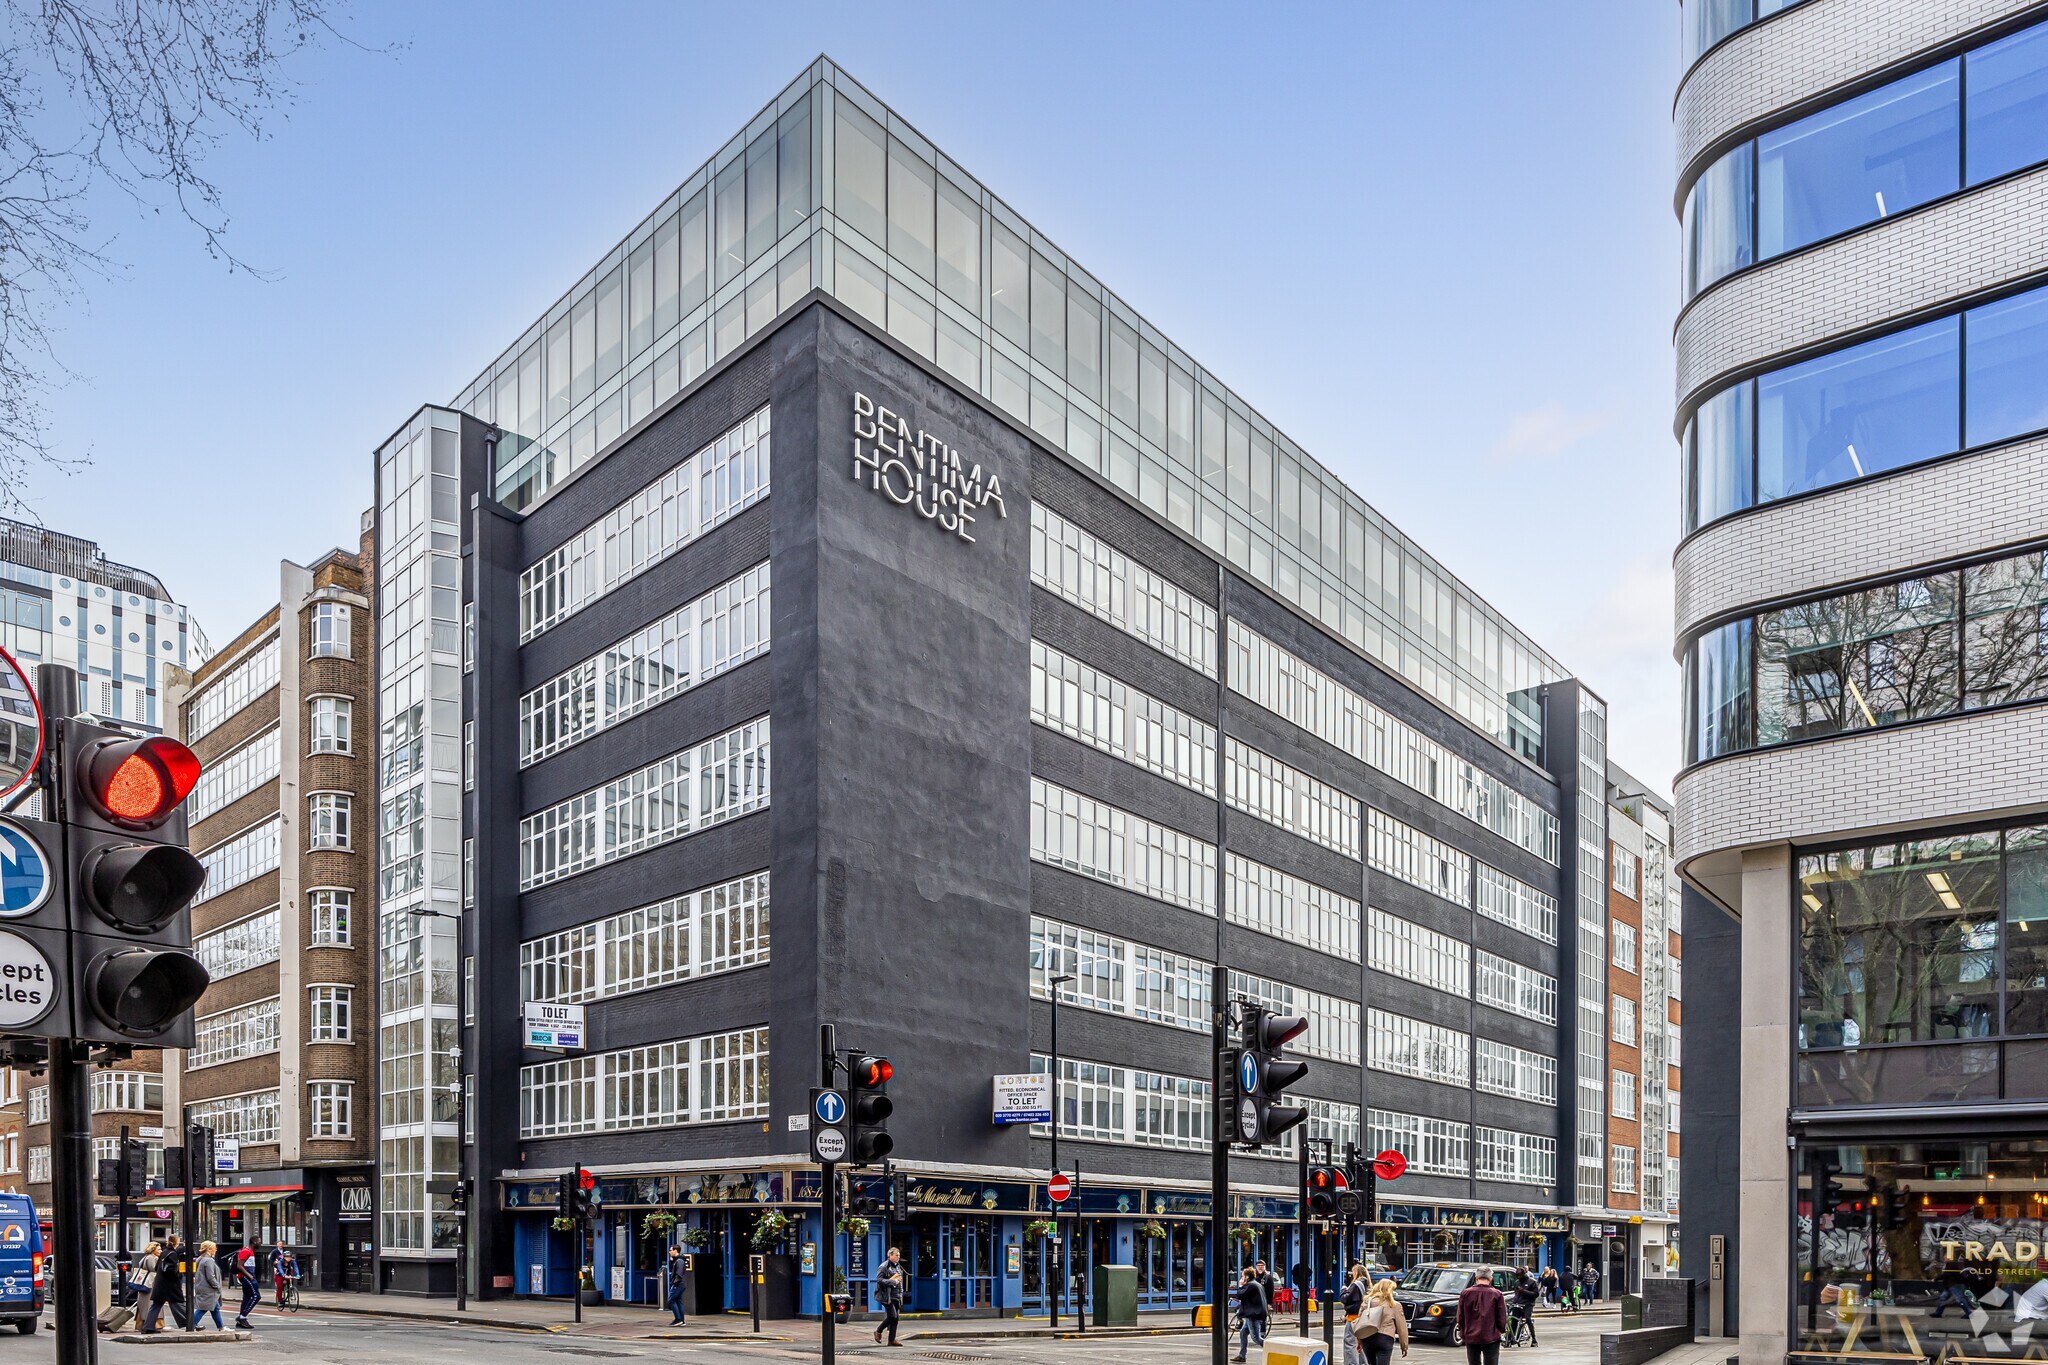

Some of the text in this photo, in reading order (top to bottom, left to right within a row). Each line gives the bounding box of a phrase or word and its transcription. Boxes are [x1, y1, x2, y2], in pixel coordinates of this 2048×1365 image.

[854, 391, 1007, 518] BENTIMA
[854, 438, 976, 543] HOUSE
[0, 963, 44, 982] ept
[0, 983, 42, 1004] les
[541, 1007, 568, 1019] TO LET
[1008, 1097, 1037, 1106] TO LET
[1241, 1110, 1255, 1120] Except
[819, 1136, 844, 1146] Except
[820, 1145, 843, 1153] cycles
[798, 1185, 823, 1198] 168-1
[922, 1186, 951, 1206] Masque
[948, 1186, 977, 1206] Haunt
[1940, 1240, 2048, 1262] TRAD
[1969, 1267, 2038, 1276] OLD STREET
